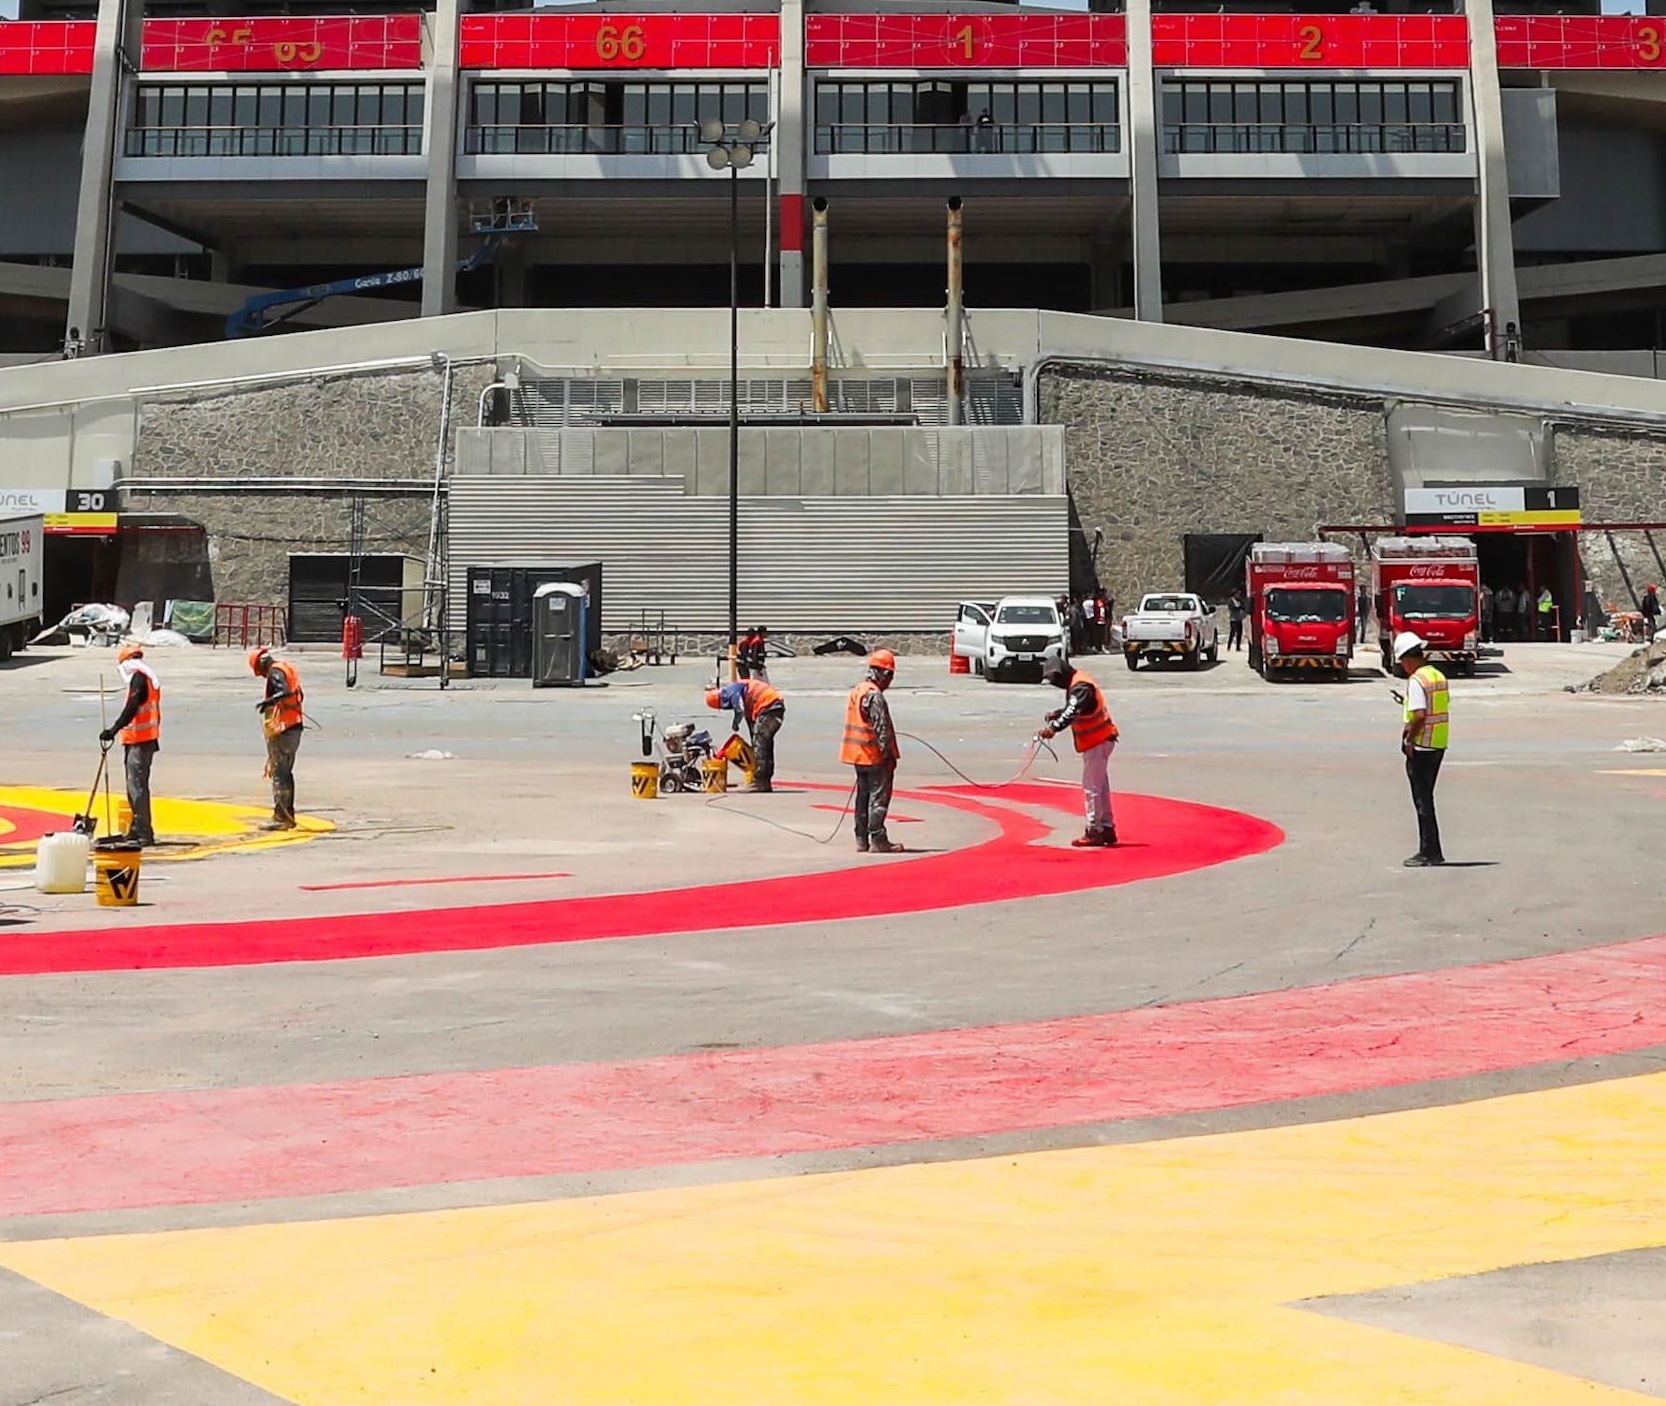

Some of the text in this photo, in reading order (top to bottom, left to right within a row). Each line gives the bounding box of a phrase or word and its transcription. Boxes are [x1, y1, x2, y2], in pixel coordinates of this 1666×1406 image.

[596, 26, 644, 61] 66
[956, 25, 973, 60] 1
[1299, 25, 1323, 60] 2
[1637, 26, 1661, 62] 3
[77, 493, 105, 511] 30
[1434, 491, 1496, 505] TÚNEL
[1546, 490, 1557, 508] 1
